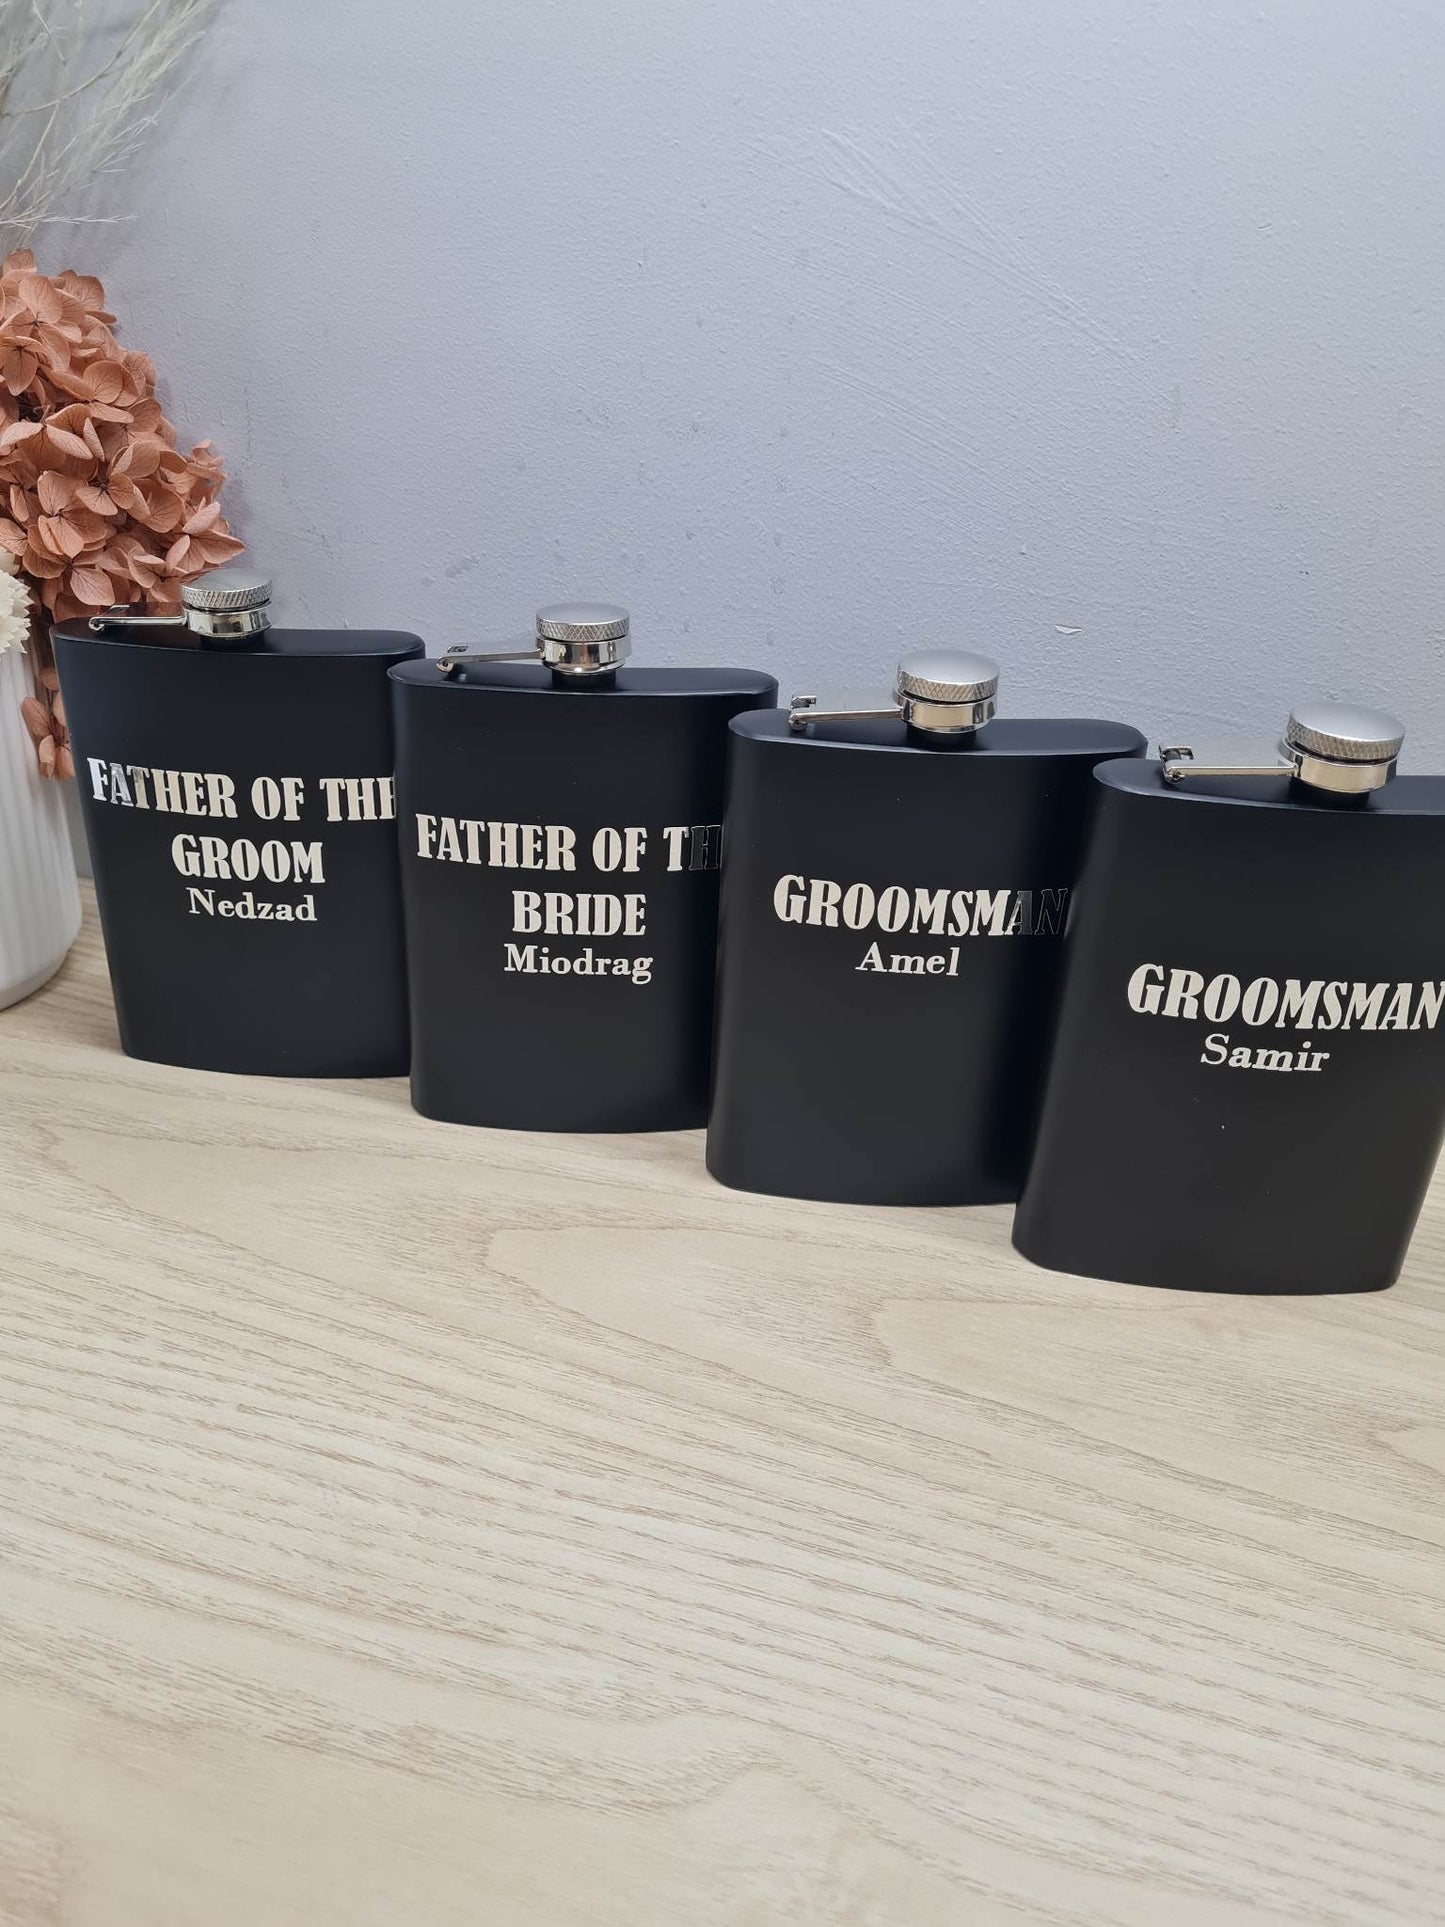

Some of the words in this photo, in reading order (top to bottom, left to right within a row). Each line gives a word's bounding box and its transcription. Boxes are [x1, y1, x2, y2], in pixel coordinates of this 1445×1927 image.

[86, 756, 238, 819] FATHER
[251, 776, 305, 821] OF
[171, 833, 326, 884] GROOM
[415, 812, 577, 872] FATHER
[592, 826, 648, 872] OF
[186, 887, 318, 921] Nedzad
[511, 890, 647, 936] BRIDE
[773, 874, 1069, 937] GROOMSMAN
[503, 943, 653, 985] Miodrag
[854, 941, 961, 976] Amel
[1127, 963, 1445, 1031] GROOMSMAN
[1200, 1033, 1330, 1072] Samir
